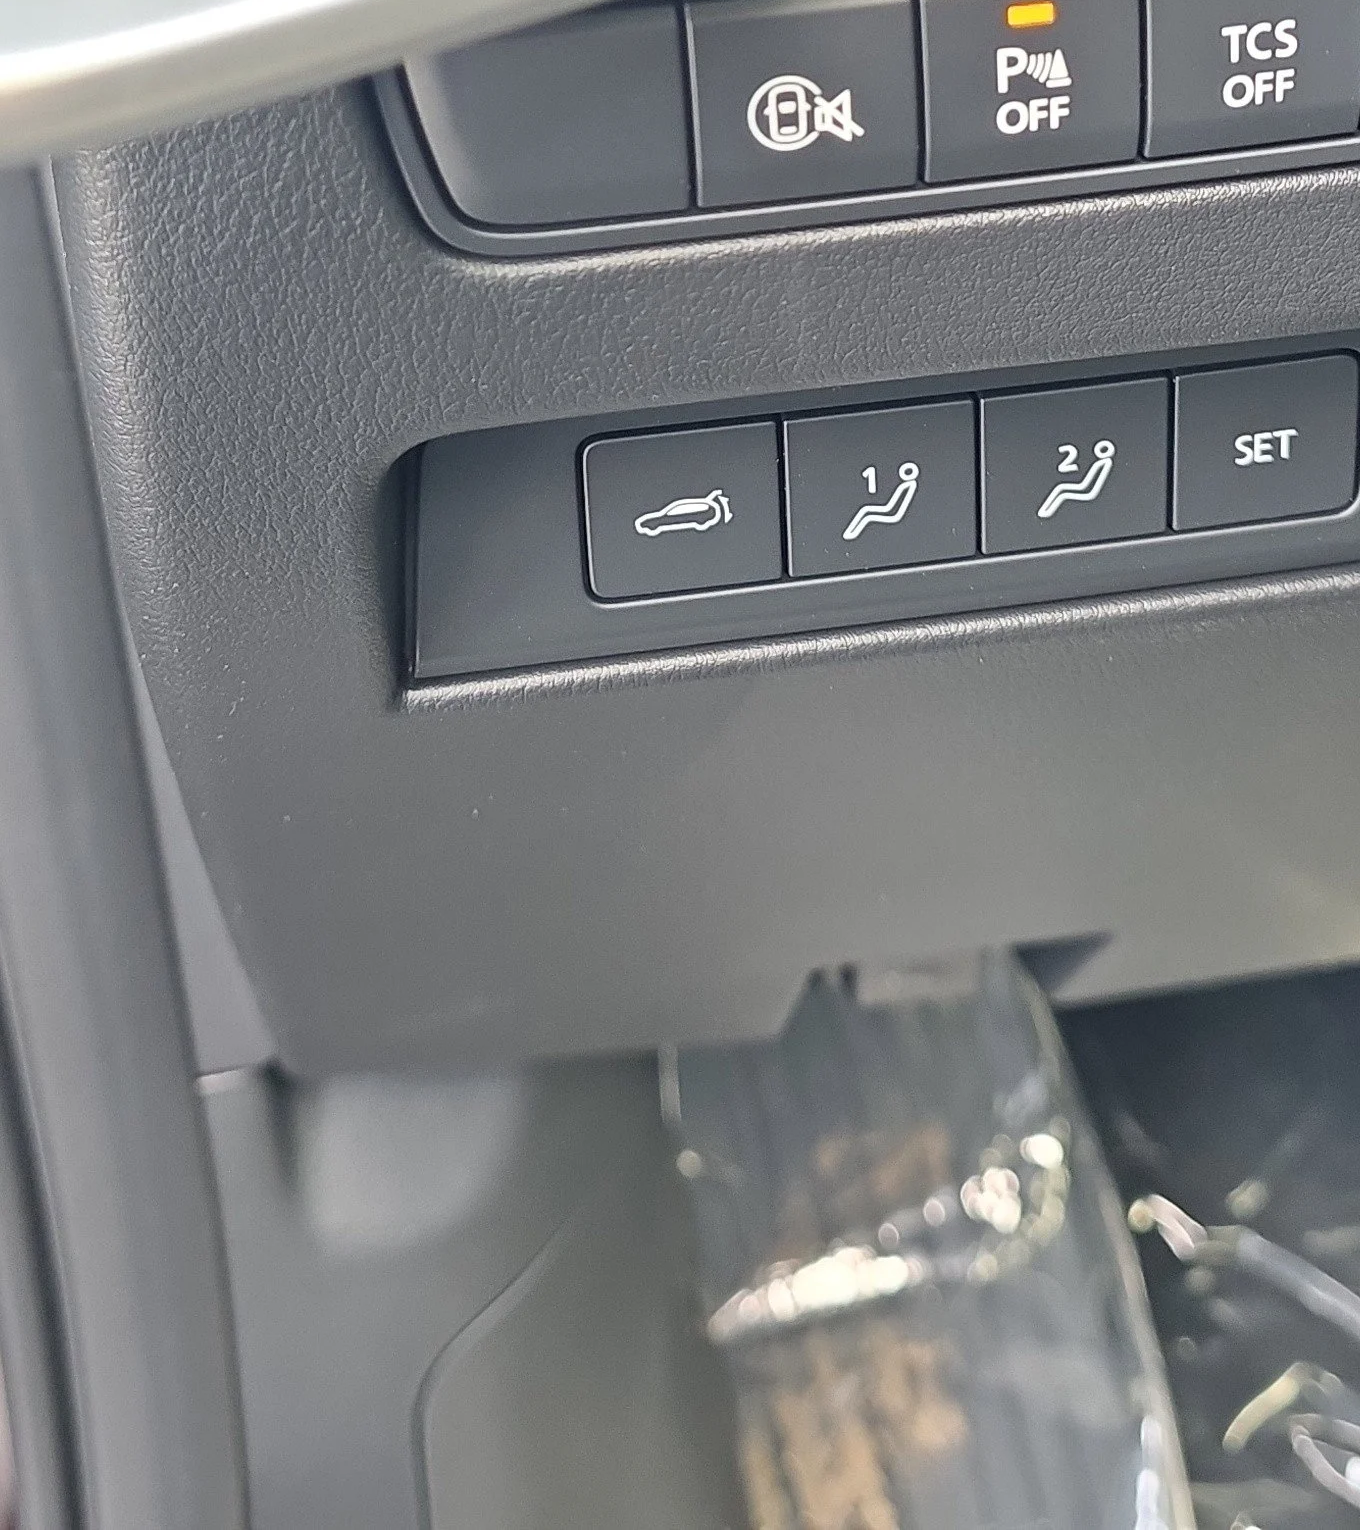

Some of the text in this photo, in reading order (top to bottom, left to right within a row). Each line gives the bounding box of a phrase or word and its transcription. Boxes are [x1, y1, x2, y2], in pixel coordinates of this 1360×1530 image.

[1221, 20, 1298, 63] TCS
[1222, 69, 1296, 108] OFF
[996, 96, 1071, 134] OFF
[1057, 444, 1079, 473] 2
[1234, 428, 1298, 466] SET
[861, 466, 878, 494] 1
